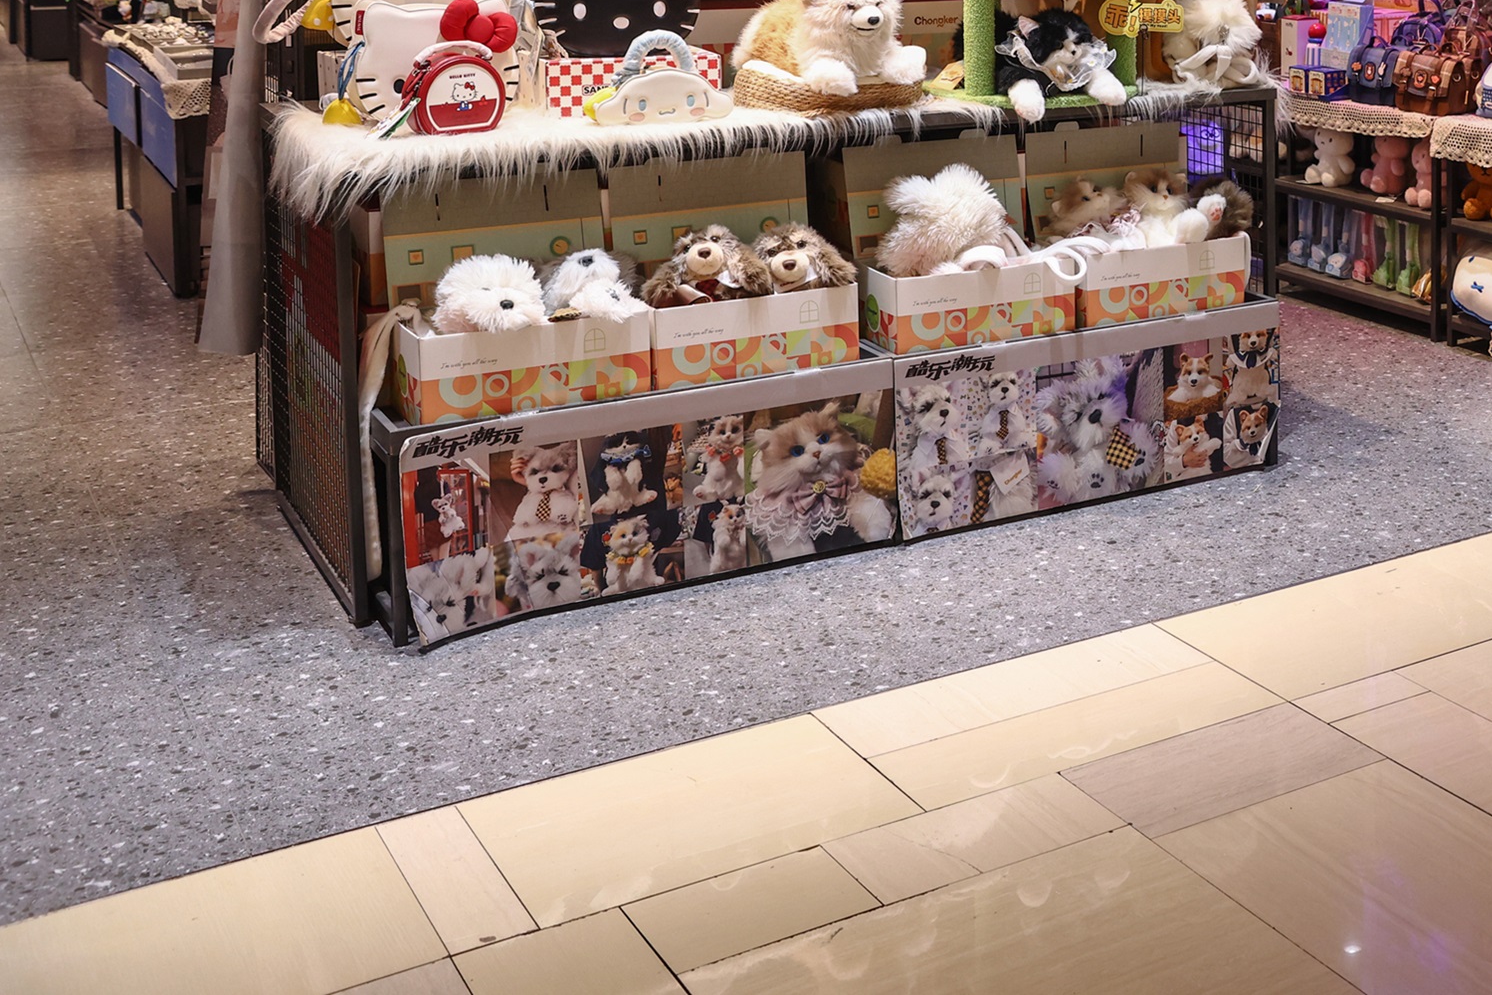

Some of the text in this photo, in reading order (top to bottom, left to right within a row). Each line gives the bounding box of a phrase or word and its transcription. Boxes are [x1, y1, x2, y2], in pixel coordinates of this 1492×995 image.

[914, 15, 959, 28] Chongker
[1138, 7, 1181, 25] 摸摸头
[905, 354, 996, 381] 酷乐潮玩
[412, 425, 524, 458] 酷乐潮玩
